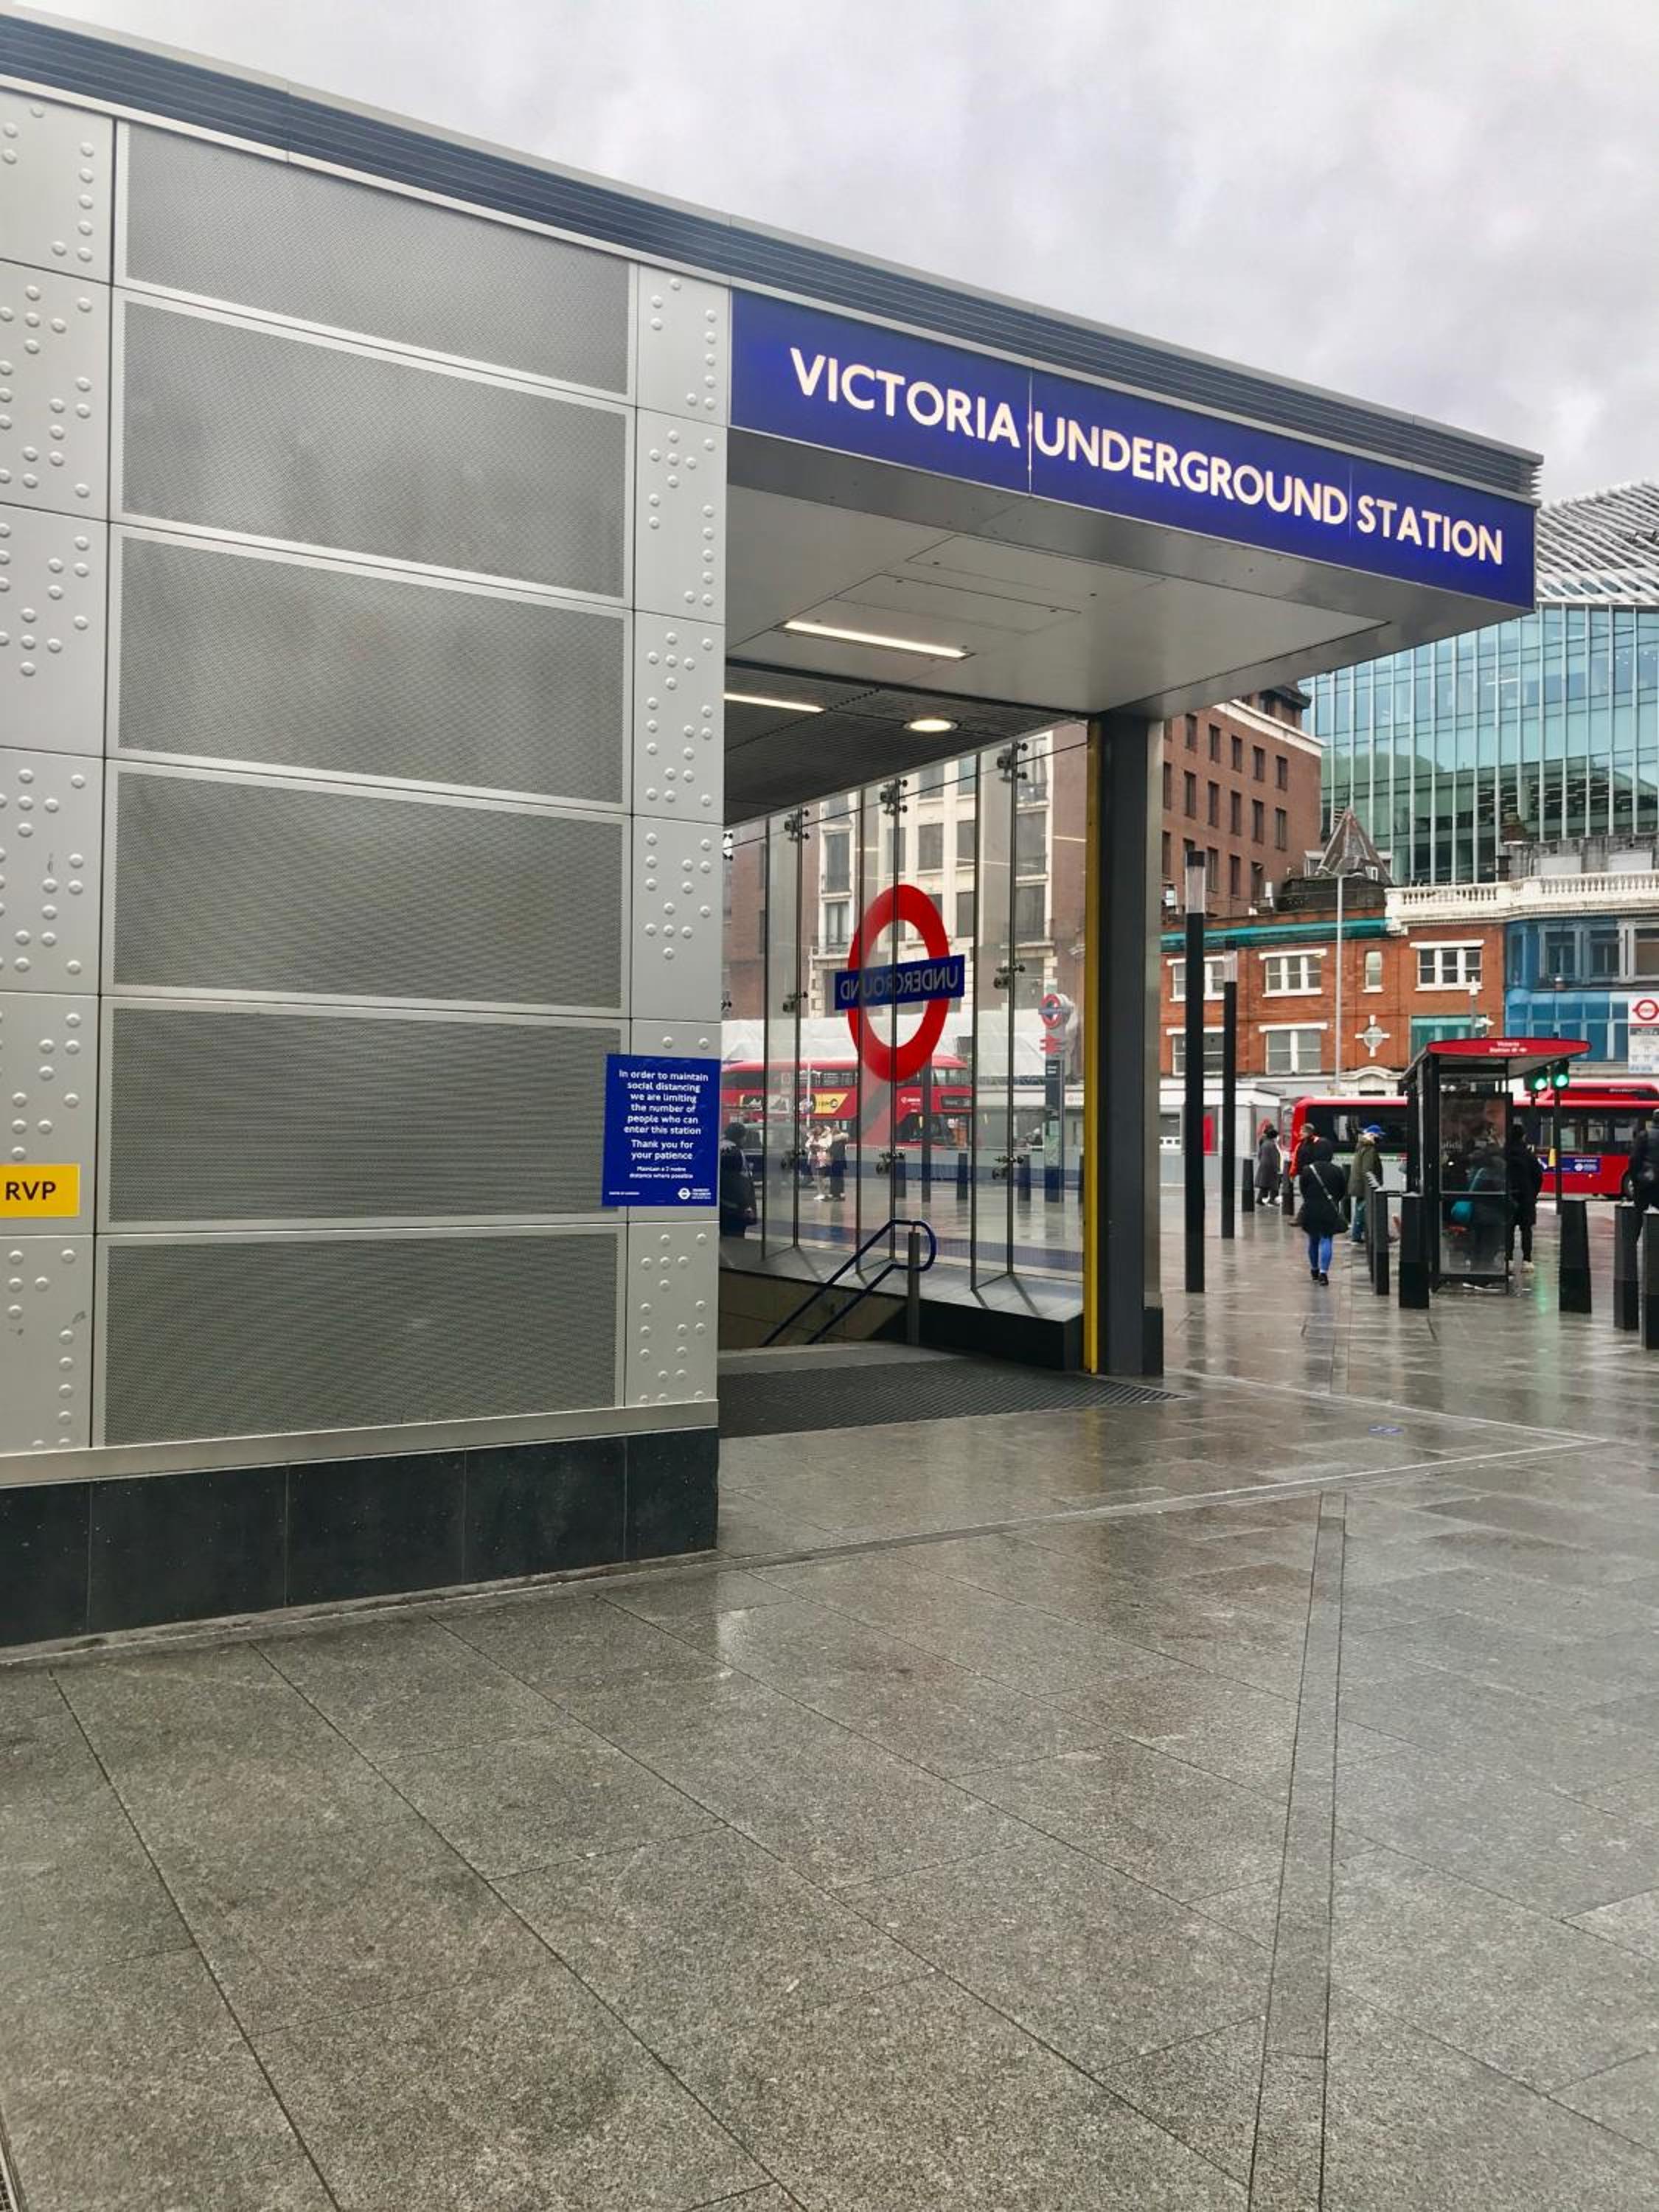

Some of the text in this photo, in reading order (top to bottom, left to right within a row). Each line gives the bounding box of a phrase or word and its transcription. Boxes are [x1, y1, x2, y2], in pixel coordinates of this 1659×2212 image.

[789, 347, 1503, 566] VICTORIA UNDERGROUND STATION
[630, 1071, 655, 1079] order
[658, 1071, 667, 1079] to
[670, 1072, 709, 1082] maintain
[627, 1081, 700, 1093] social distancing
[663, 1093, 697, 1103] limiting
[627, 1115, 658, 1124] people
[651, 1126, 667, 1134] this
[670, 1127, 701, 1135] station
[631, 1140, 694, 1150] Thank you for
[654, 1152, 693, 1160] patience
[5, 1180, 56, 1200] RVP
